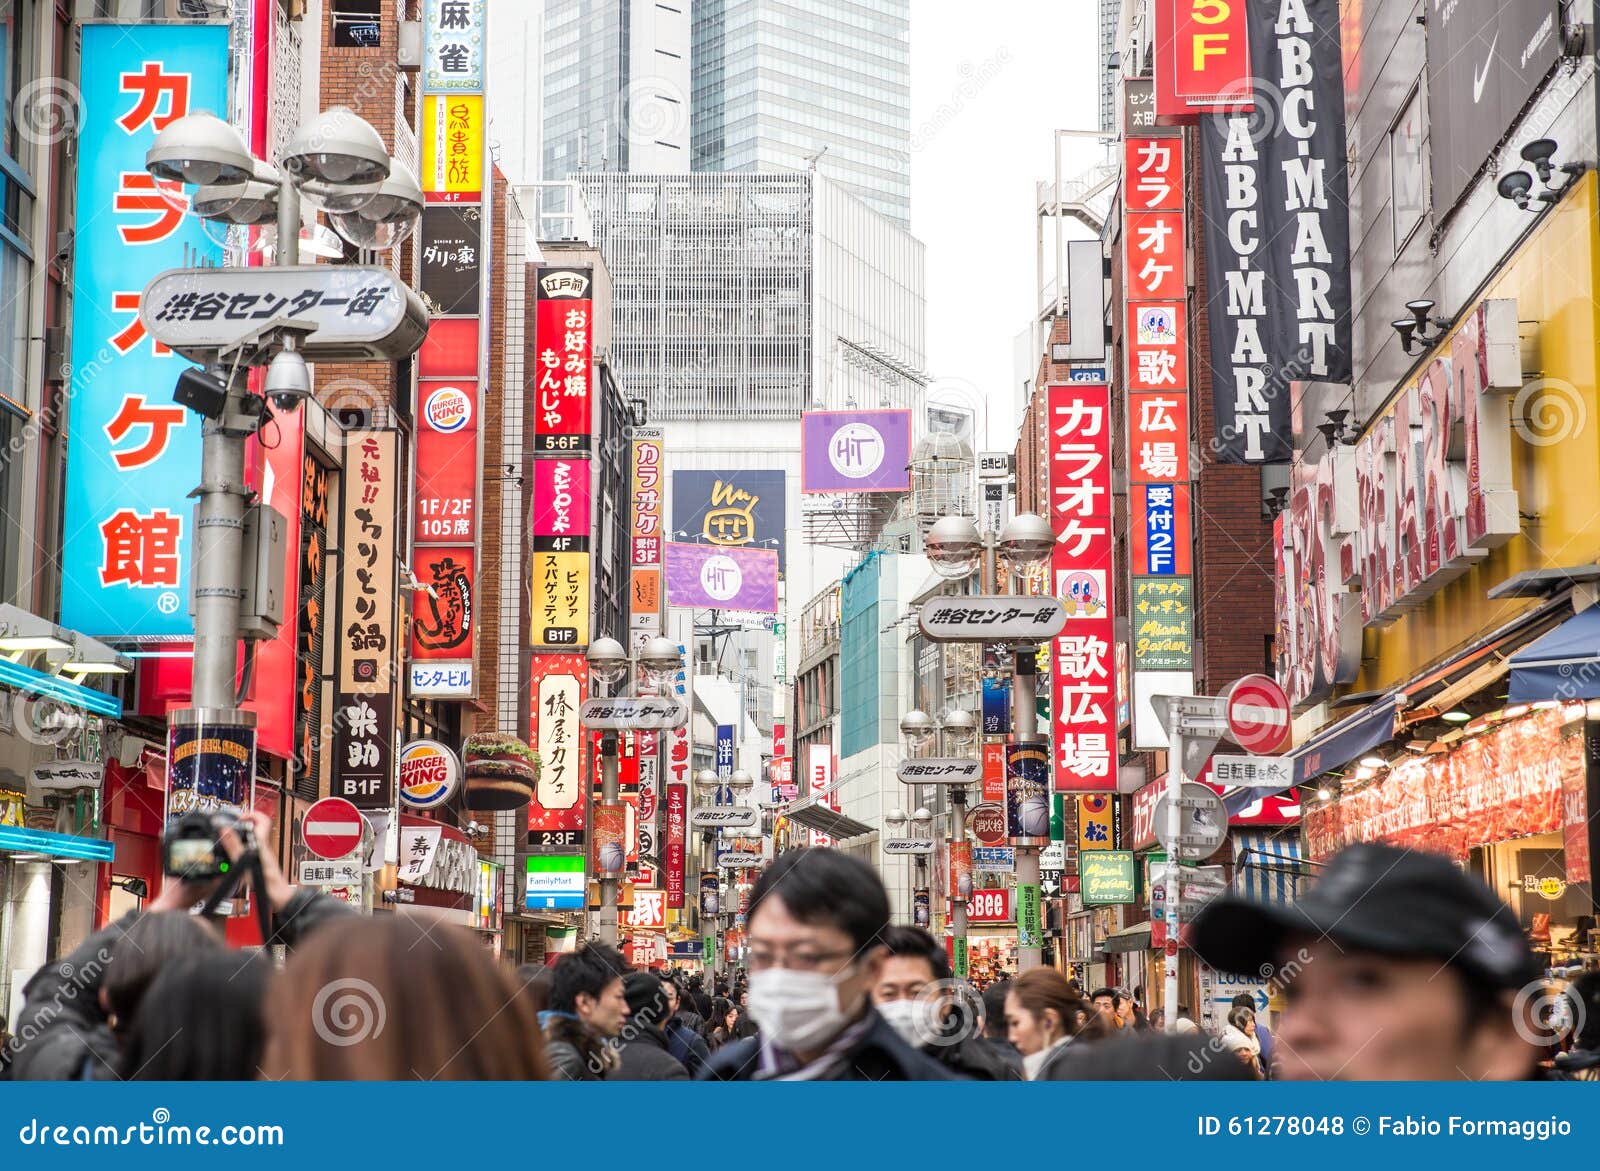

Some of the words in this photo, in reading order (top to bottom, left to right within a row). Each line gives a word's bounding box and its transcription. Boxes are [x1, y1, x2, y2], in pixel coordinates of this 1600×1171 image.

[439, 0, 471, 73] 麻雀
[1275, 0, 1336, 376] ABC-MART
[444, 193, 461, 202] 4F
[1137, 142, 1173, 292] カラオケ
[423, 245, 475, 267] ダリの家
[545, 277, 584, 292] 江戸前
[1222, 117, 1271, 460] ABC-MART
[156, 287, 391, 322] 渋谷センター街
[564, 309, 587, 397] お好み焼
[540, 348, 562, 428] もんじゃ
[432, 397, 463, 412] BURGER
[433, 404, 465, 424] KING
[1138, 350, 1178, 479] 歌広場
[1055, 398, 1106, 558] カラオケ
[637, 442, 659, 534] カラオケ
[421, 519, 470, 536] 105席
[552, 538, 572, 550] 4F
[635, 538, 656, 550] 受付
[635, 551, 656, 563] 3F
[348, 508, 386, 652] ちりとり鍋
[544, 555, 558, 625] スパゲッティ
[566, 571, 578, 618] ピッツァ
[640, 616, 651, 624] 2F
[929, 608, 1057, 624] 渋谷センター街
[548, 630, 573, 641] B1F
[1138, 620, 1188, 636] Miami
[413, 671, 471, 687] センタービル
[585, 706, 680, 719] 渋谷センター街
[1058, 635, 1111, 778] 歌広場
[348, 701, 379, 768] 米助
[545, 690, 574, 794] 椿屋カフェ
[401, 756, 447, 773] BURGER
[902, 765, 977, 776] 渋谷センター街
[1217, 763, 1288, 782] 自転車を除く
[343, 780, 381, 795] B1F
[401, 768, 447, 789] KING
[695, 812, 752, 820] 渋谷センター街
[976, 819, 1003, 832] 消火栓
[1085, 821, 1108, 842] 松
[886, 841, 933, 849] 渋谷センター街
[409, 836, 431, 873] 寿司
[669, 870, 681, 878] 2F
[1084, 863, 1124, 878] Miami
[530, 876, 573, 886] FamilyMart
[669, 882, 681, 890] 3F
[626, 893, 662, 926] 豚
